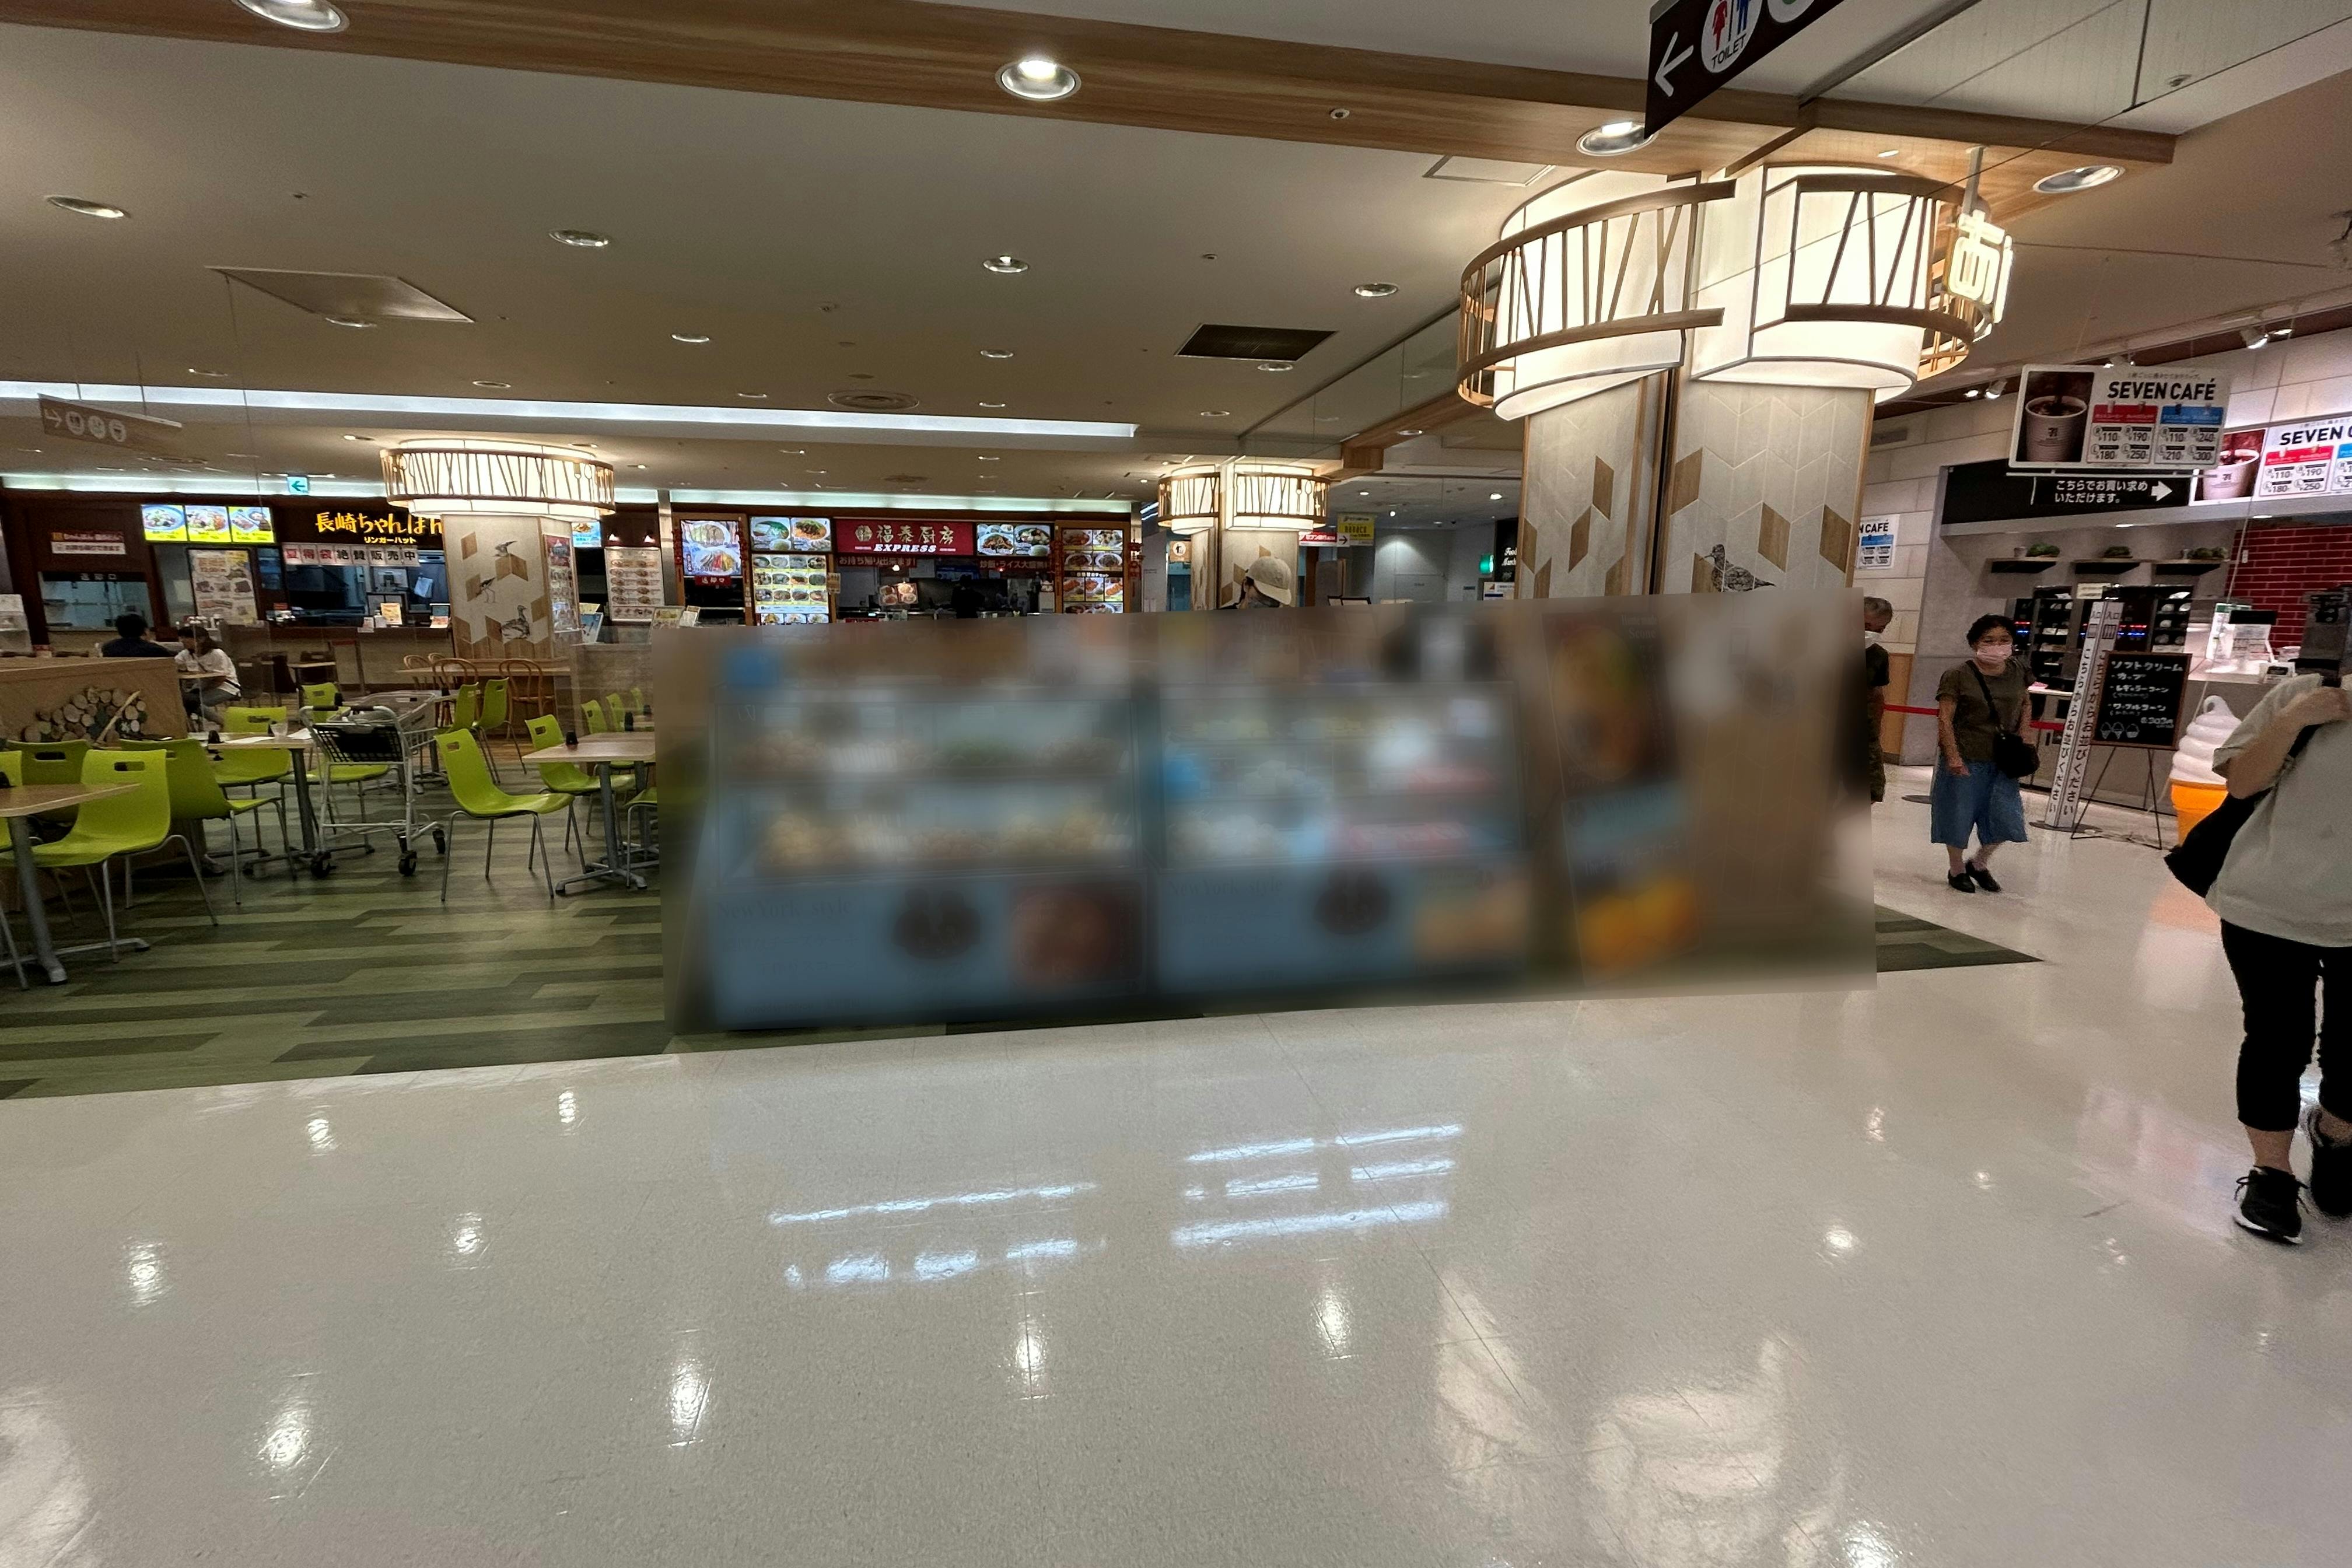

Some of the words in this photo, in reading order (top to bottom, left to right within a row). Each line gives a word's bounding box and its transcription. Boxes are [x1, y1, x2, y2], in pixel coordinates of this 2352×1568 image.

[1712, 33, 1746, 69] TOILET
[2107, 382, 2168, 400] SEVEN
[2170, 378, 2217, 400] CAFÉ
[2279, 426, 2344, 446] SEVEN
[2056, 480, 2148, 492] こちらでお買い求め
[2054, 493, 2120, 503] いただけます。
[1865, 519, 1890, 533] CAFÉ
[873, 544, 937, 552] EXPRESS
[2111, 661, 2184, 671] ソフトクリーム
